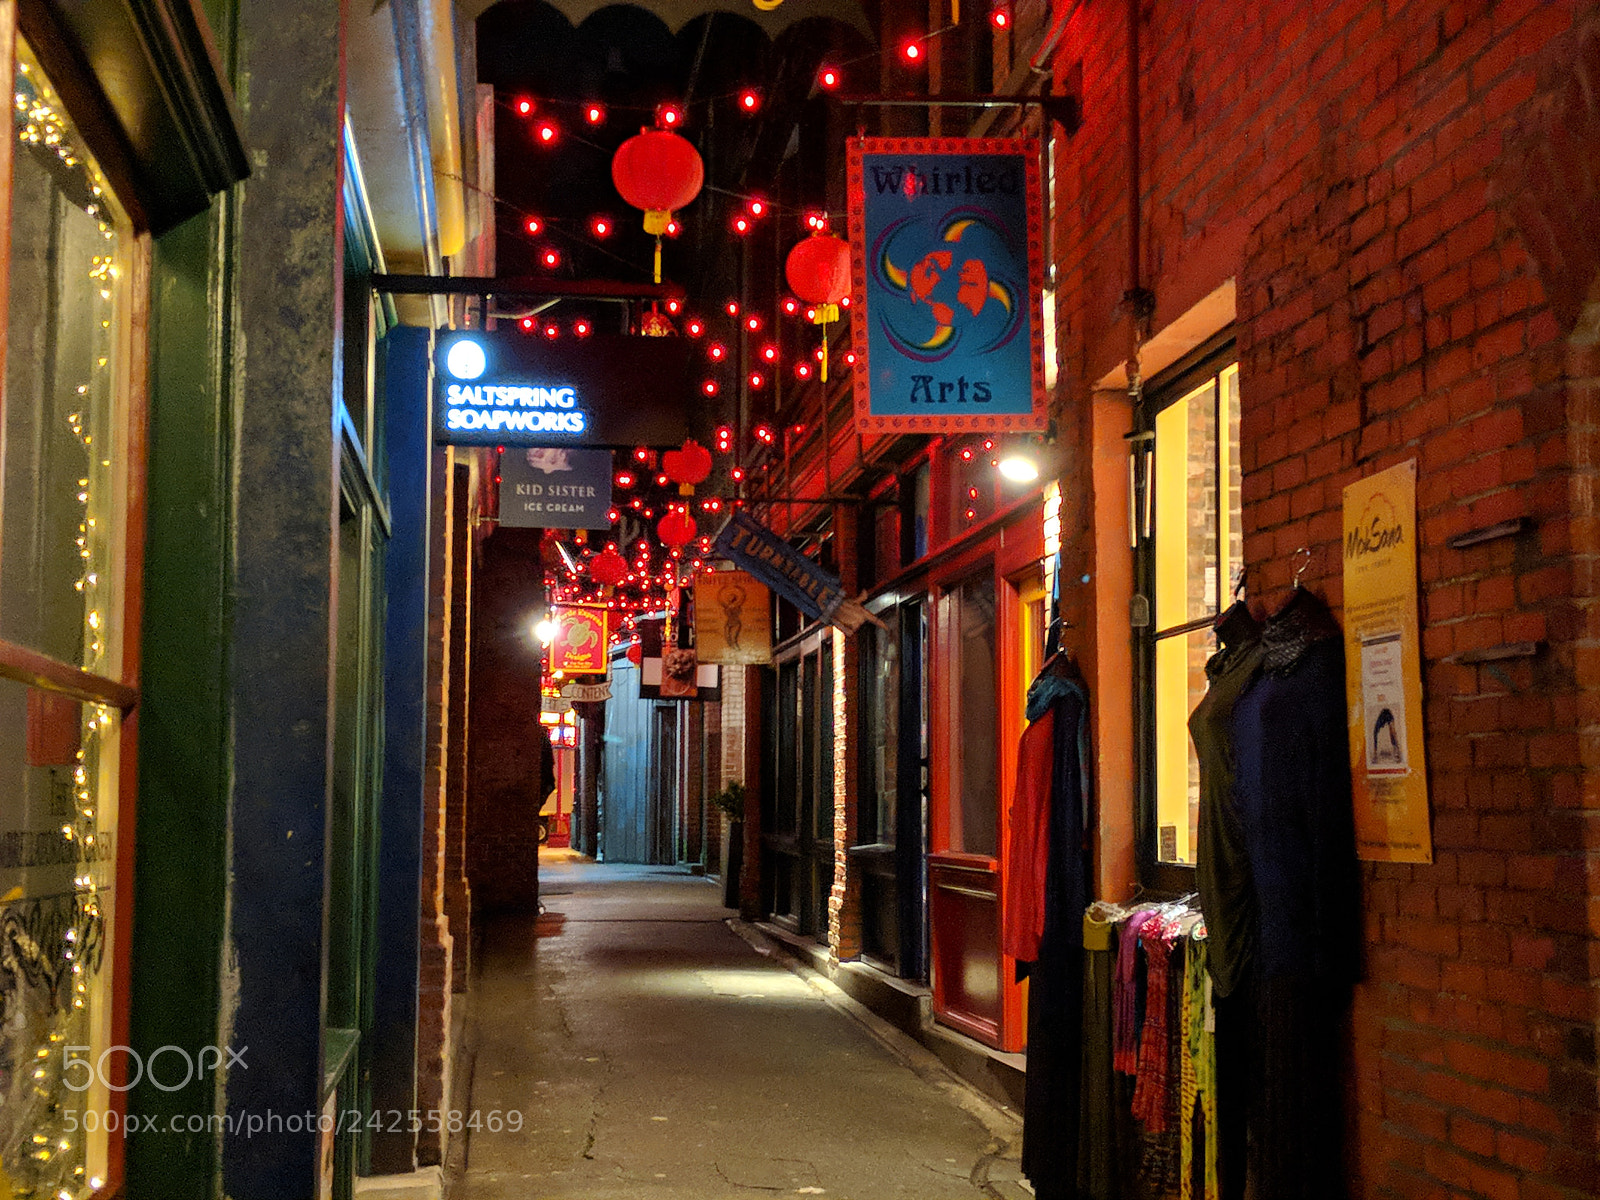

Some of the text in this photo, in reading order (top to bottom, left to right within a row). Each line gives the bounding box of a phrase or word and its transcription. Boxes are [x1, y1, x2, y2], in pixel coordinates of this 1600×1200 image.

[871, 165, 1018, 196] Whirled
[446, 384, 575, 408] SALTSPRING
[910, 374, 993, 404] Arts
[446, 408, 585, 433] SOAPWORKS
[515, 483, 597, 498] KID SISTER
[523, 503, 585, 513] ICE CREAM
[730, 523, 835, 611] TURNTABLE
